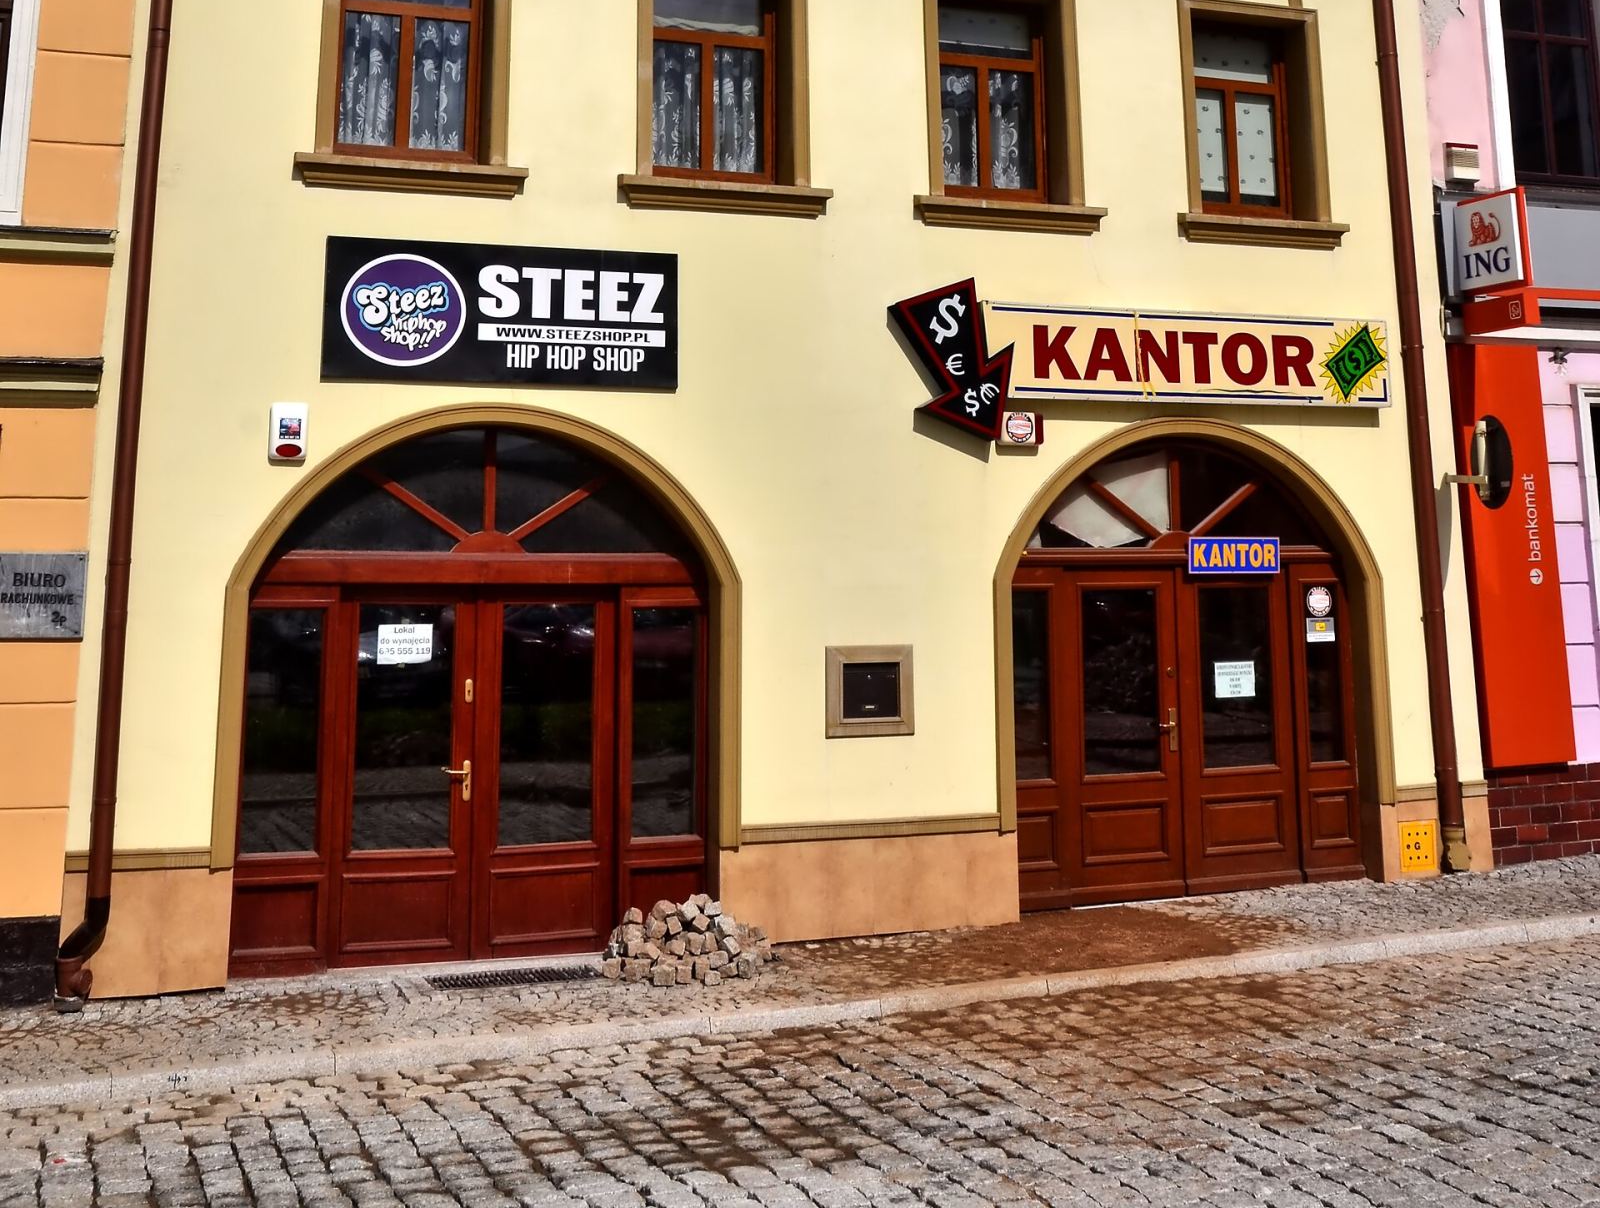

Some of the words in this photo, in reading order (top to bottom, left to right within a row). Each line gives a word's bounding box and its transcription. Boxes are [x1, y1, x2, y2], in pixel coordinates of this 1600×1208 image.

[1463, 246, 1511, 279] ING
[356, 285, 444, 325] Steez
[478, 265, 665, 324] STEEZ
[496, 327, 651, 343] WWW.STEEZSHOP.PL
[506, 344, 540, 369] HIP
[546, 345, 587, 370] HOP
[592, 347, 645, 372] SHOP
[1032, 324, 1316, 387] KANTOR
[1521, 473, 1542, 562] bankomat
[1193, 543, 1276, 568] KANTOR
[13, 572, 66, 588] BIURO
[0, 592, 74, 605] RACHUNKOWE
[394, 626, 415, 634] Lokal
[397, 647, 413, 655] 555
[415, 646, 431, 655] 119
[1414, 841, 1421, 851] G
